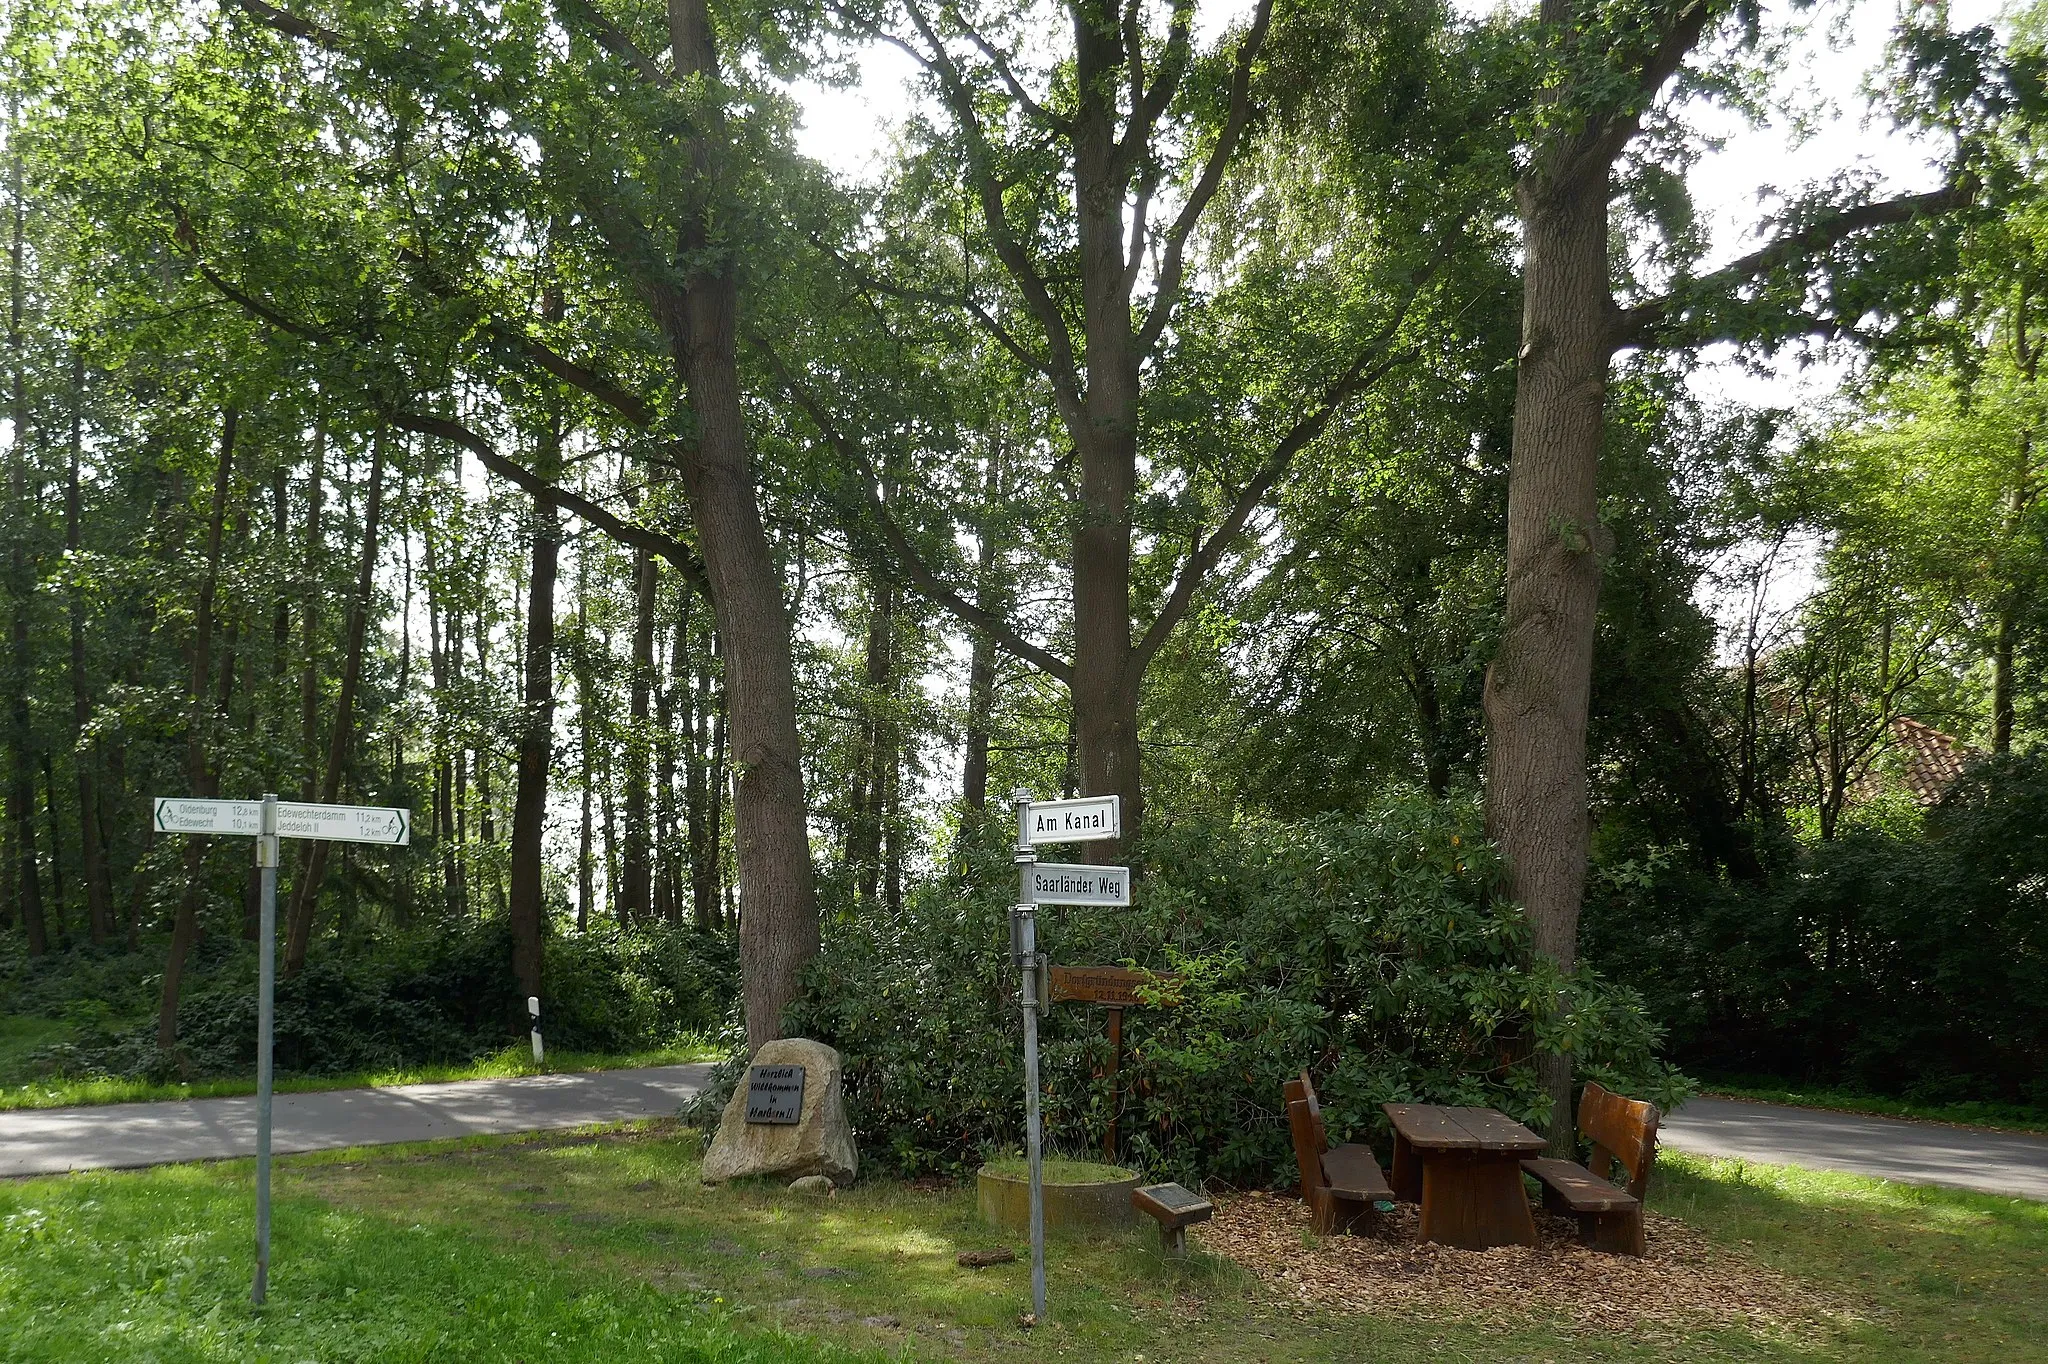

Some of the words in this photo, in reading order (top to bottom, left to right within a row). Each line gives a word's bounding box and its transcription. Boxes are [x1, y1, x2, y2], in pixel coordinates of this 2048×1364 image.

[179, 804, 218, 817] Oldenburg
[232, 806, 248, 816] 12,8
[248, 807, 259, 816] km
[277, 807, 346, 821] Edewechterdamm
[371, 814, 381, 823] km
[179, 818, 214, 828] Edewecht
[232, 819, 247, 829] 10,1
[248, 821, 259, 829] km
[1036, 814, 1057, 832] Am
[1065, 809, 1105, 830] Kanal
[277, 820, 312, 832] Jeddeloh
[313, 823, 319, 832] II
[371, 828, 381, 837] km
[1035, 874, 1093, 893] Saarländer
[1098, 877, 1120, 898] Weg
[760, 1069, 794, 1078] Herzlich
[750, 1082, 800, 1092] Willkommen
